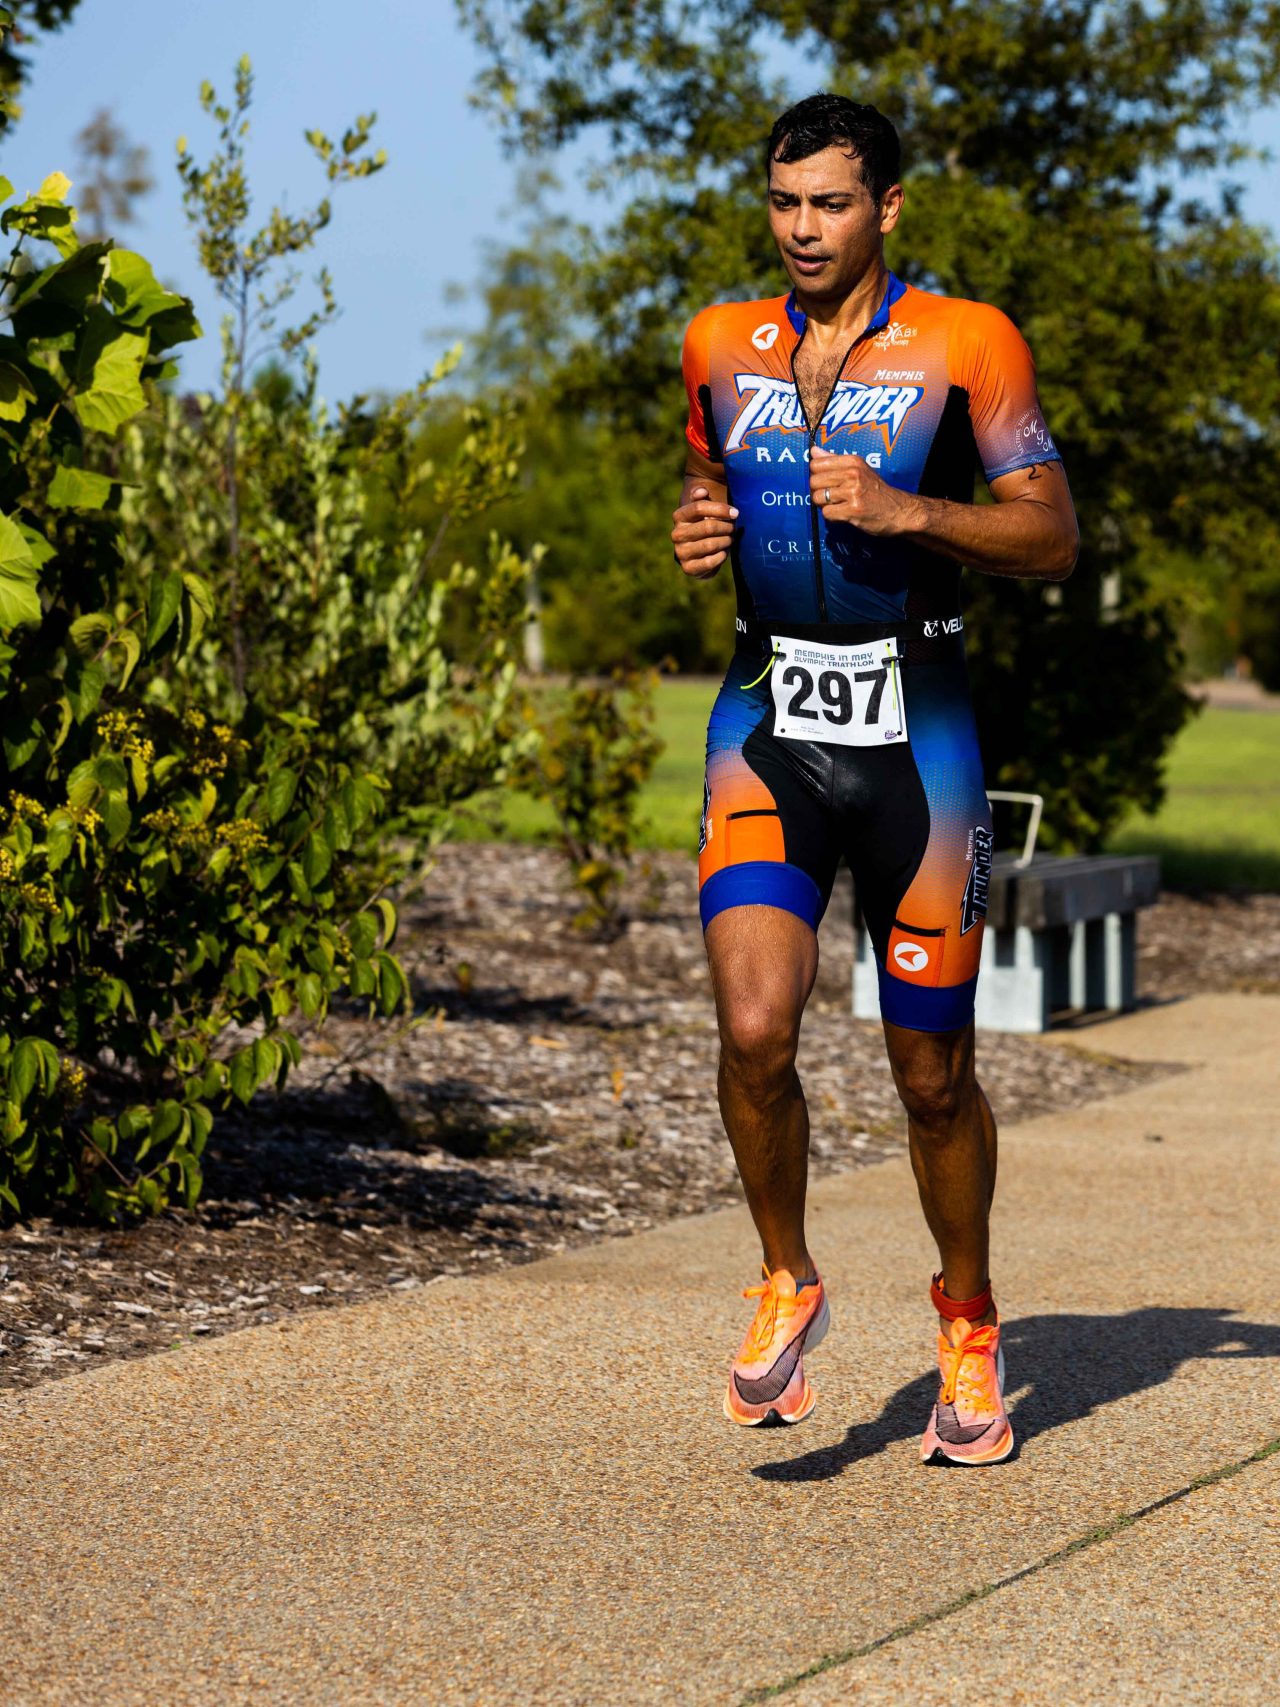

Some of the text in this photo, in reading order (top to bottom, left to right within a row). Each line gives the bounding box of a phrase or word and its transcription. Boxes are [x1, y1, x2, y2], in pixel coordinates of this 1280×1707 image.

[874, 369, 925, 381] MEMPHIS
[725, 373, 924, 452] THUNDER
[794, 648, 836, 661] MEMPHIS
[794, 656, 875, 668] OLYMPIC TRIATHLON
[782, 665, 888, 726] 297
